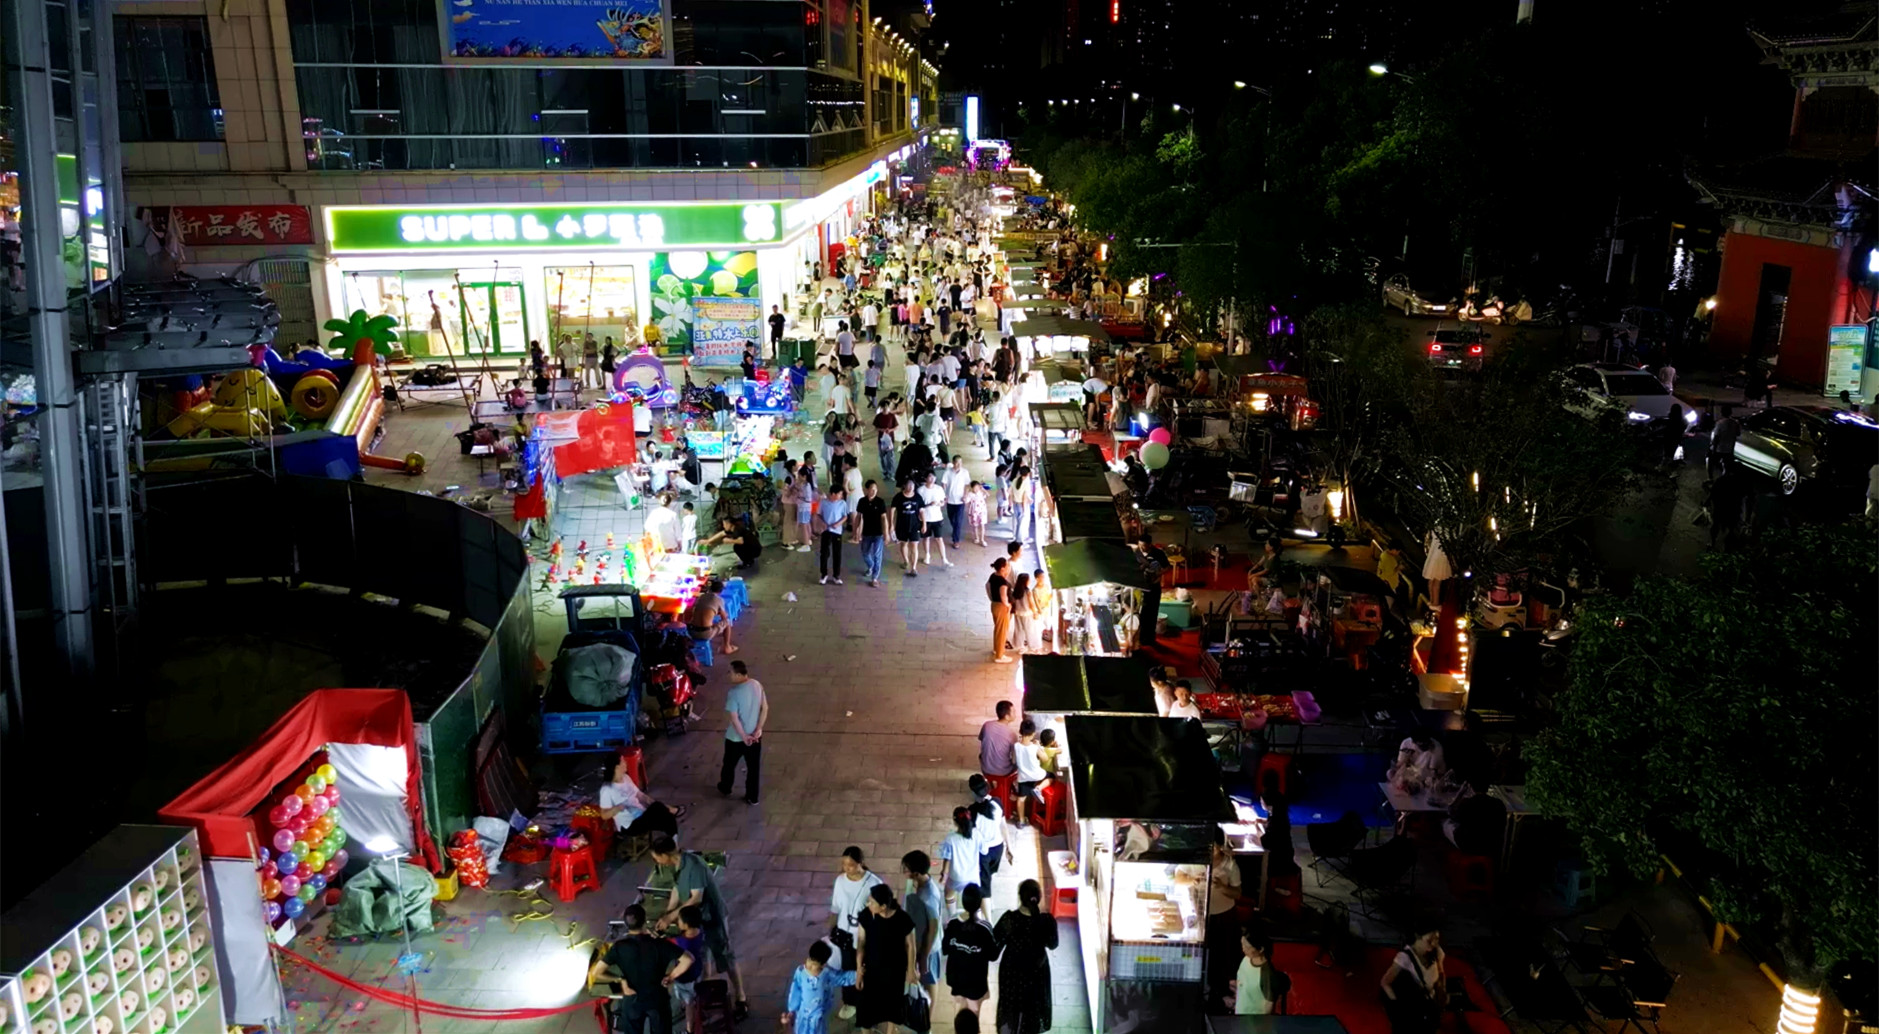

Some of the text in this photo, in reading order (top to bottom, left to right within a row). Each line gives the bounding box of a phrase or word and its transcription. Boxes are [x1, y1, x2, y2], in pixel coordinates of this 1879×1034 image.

[176, 208, 293, 240] 新品发布
[400, 214, 549, 242] SUPER L
